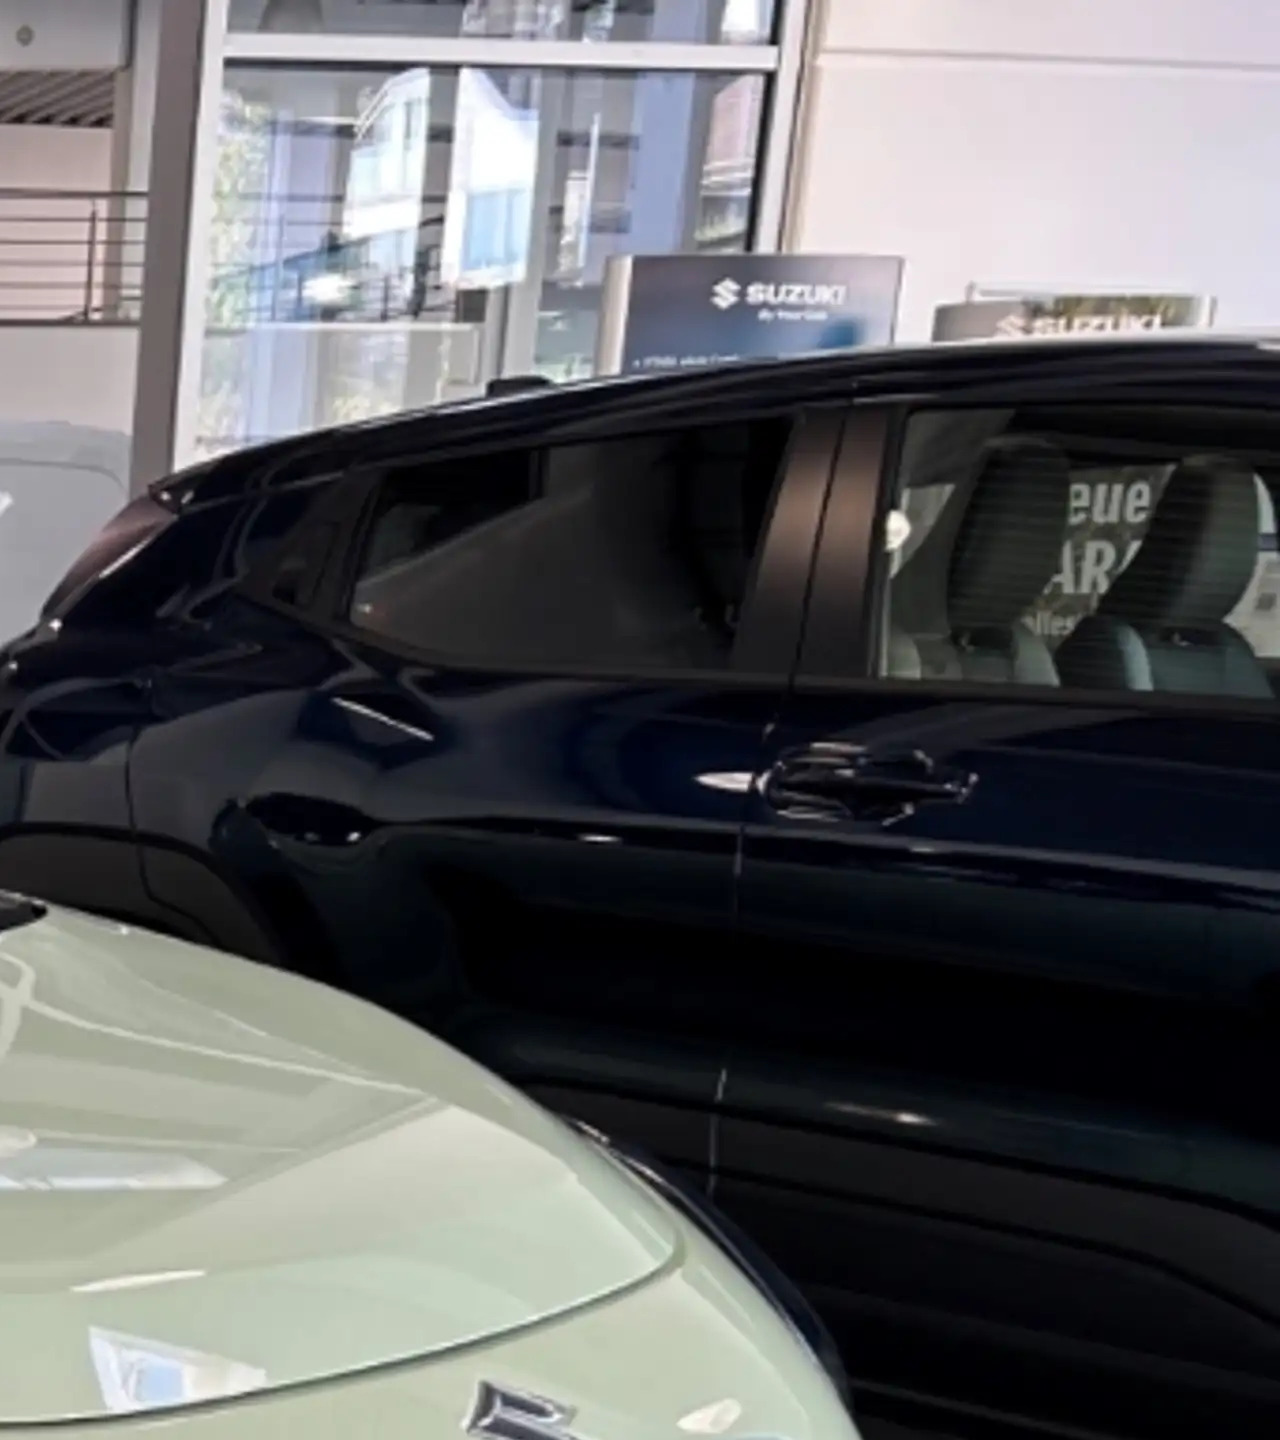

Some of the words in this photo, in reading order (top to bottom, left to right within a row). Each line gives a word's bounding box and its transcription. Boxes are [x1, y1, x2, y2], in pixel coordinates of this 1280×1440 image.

[745, 283, 846, 306] SUZUKI
[1032, 313, 1162, 335] SUZUKI
[1068, 480, 1151, 525] eue
